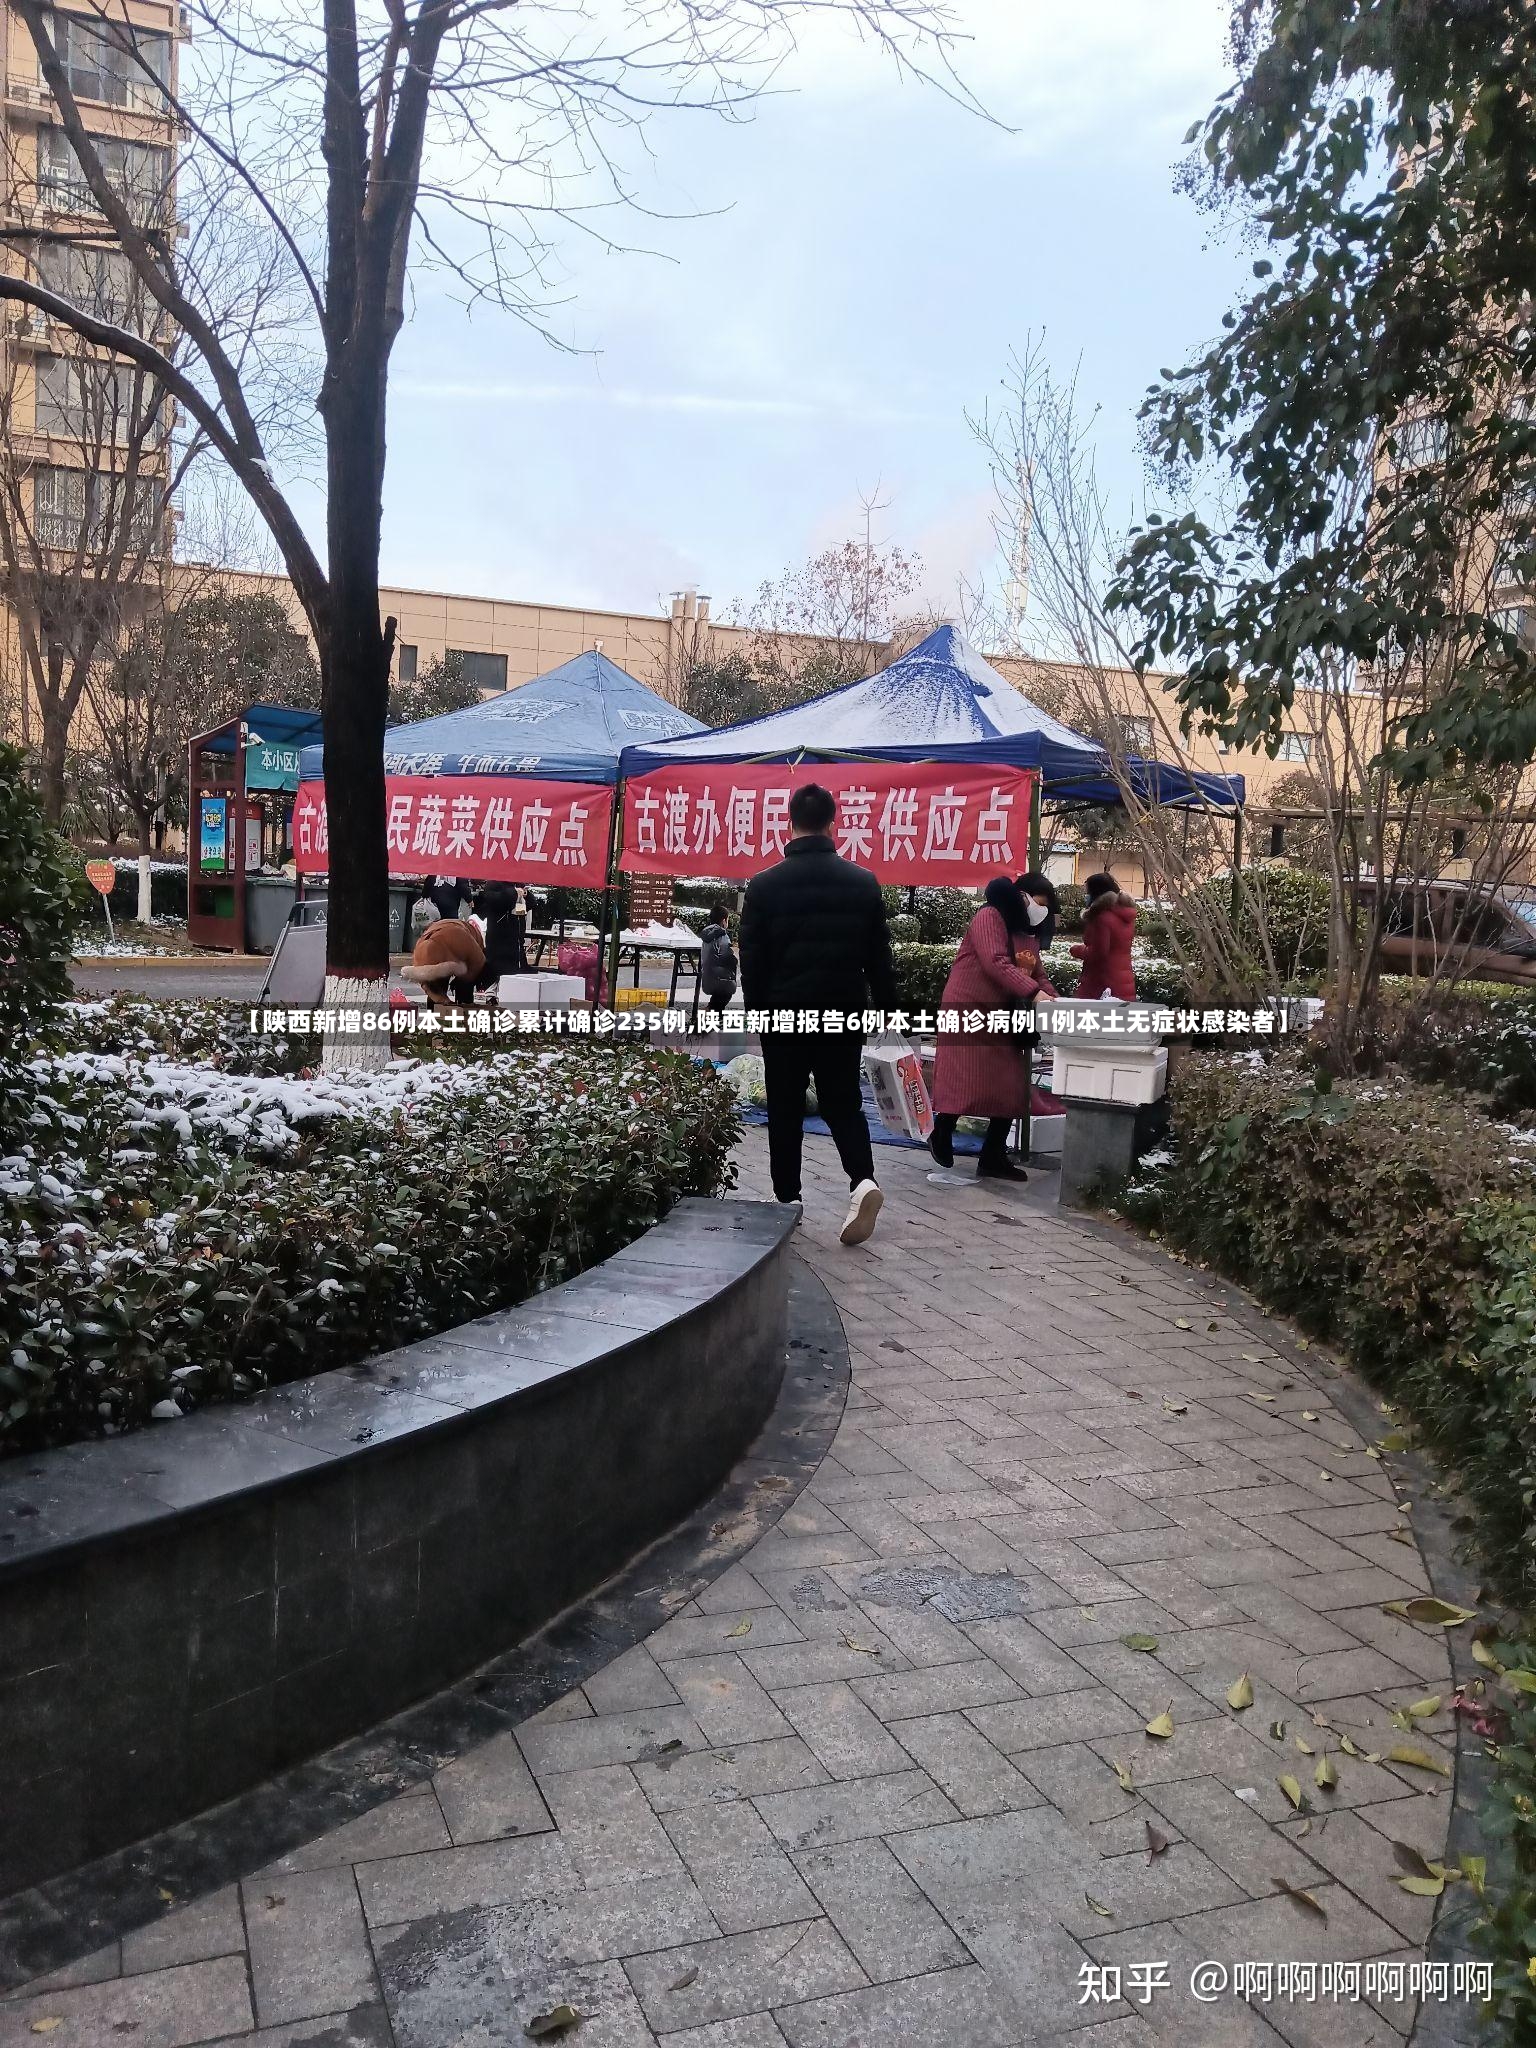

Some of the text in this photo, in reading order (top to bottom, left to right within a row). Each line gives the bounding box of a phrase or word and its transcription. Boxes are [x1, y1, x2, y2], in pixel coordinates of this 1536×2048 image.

[634, 785, 1014, 863] 古渡办便民菜供应点
